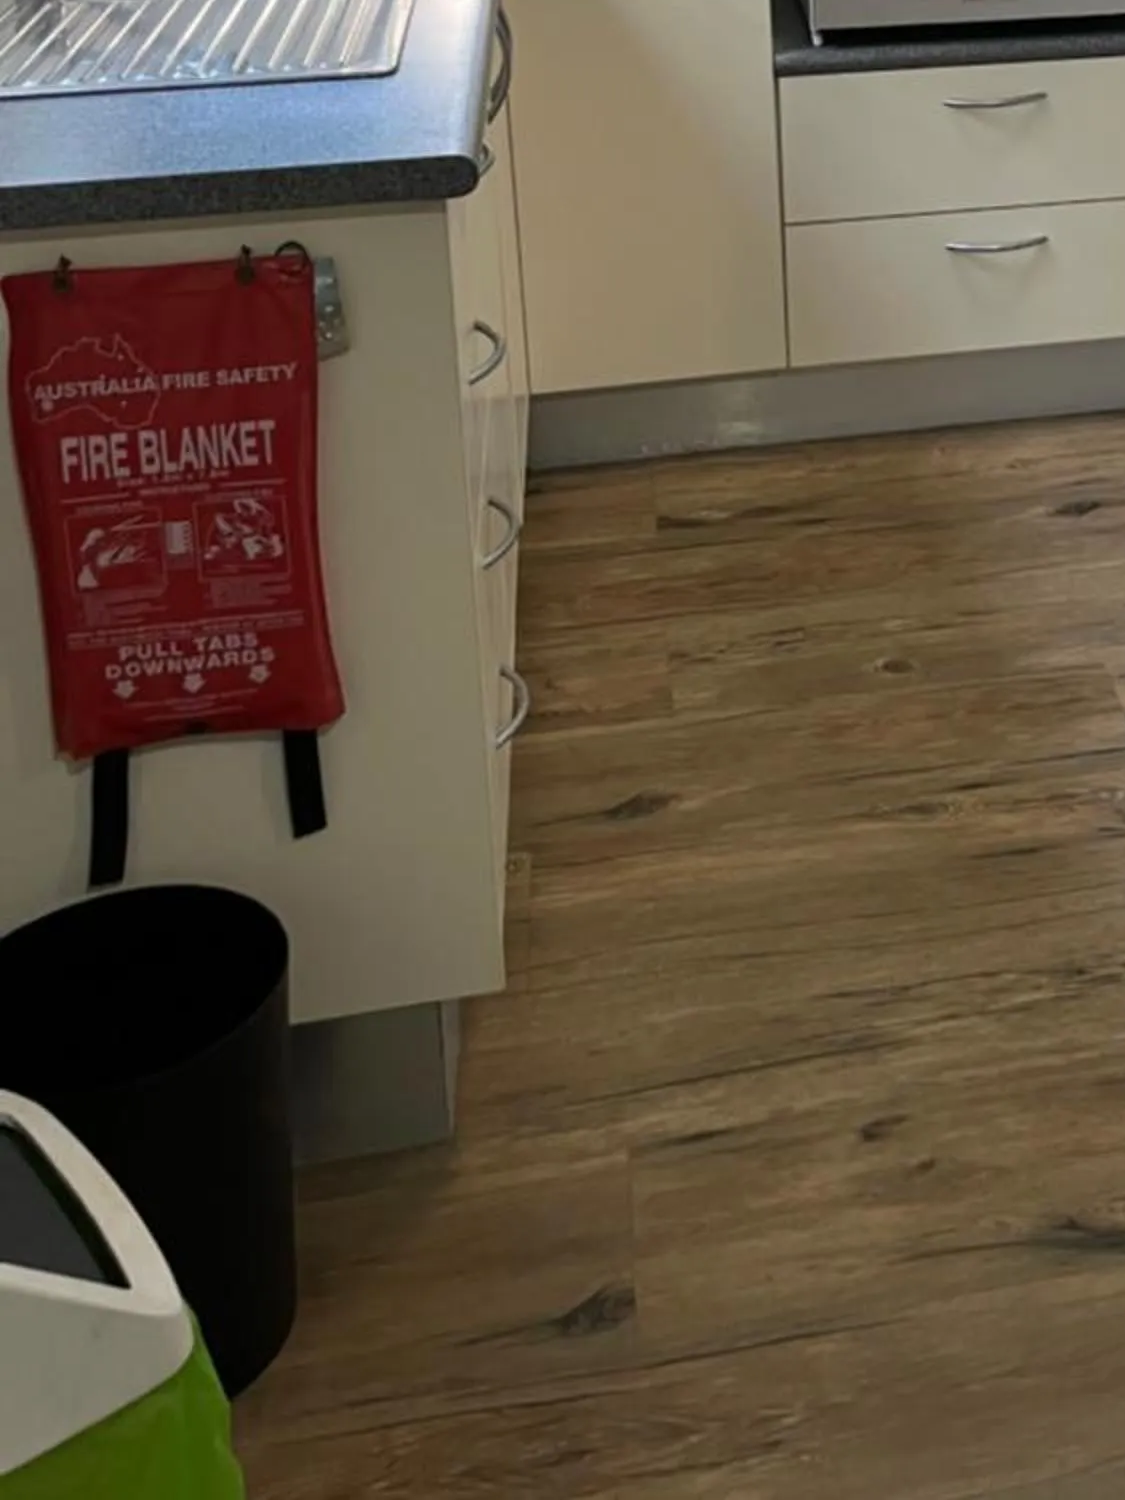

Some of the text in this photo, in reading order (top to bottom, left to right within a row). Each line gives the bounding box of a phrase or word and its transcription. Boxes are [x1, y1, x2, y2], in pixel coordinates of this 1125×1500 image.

[34, 362, 298, 400] AUSTRALIA FIRE SAFETY
[60, 432, 131, 484] FIRE
[138, 419, 277, 475] BLANKET
[104, 646, 276, 680] DOWNWARDS
[118, 631, 258, 662] PULL TABS
